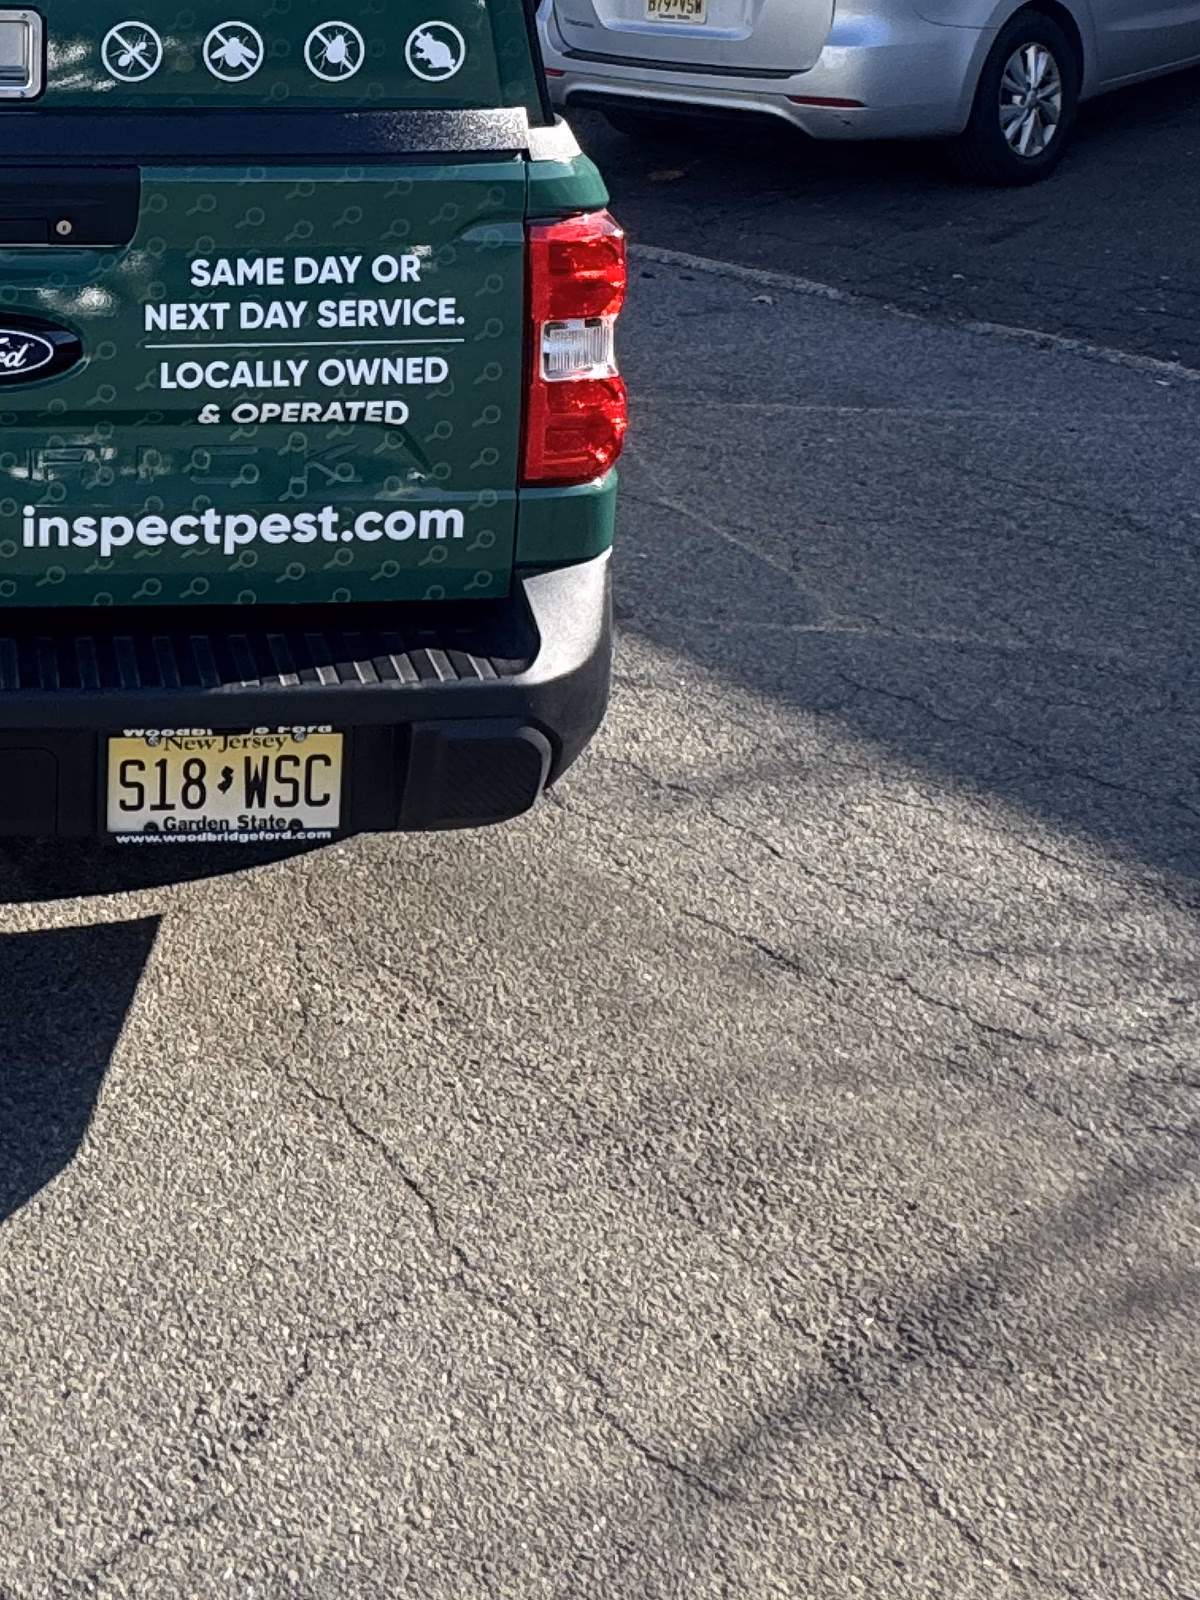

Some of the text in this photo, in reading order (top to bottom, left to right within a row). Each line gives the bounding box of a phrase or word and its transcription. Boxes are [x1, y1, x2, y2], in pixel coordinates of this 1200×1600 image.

[190, 254, 421, 287] SAME DAY OR
[145, 297, 465, 331] NEXT DAY SERVICE.
[160, 356, 449, 389] LOCALLY OWNED
[197, 400, 409, 425] & OPERATED
[23, 505, 465, 556] inspectpest.com
[163, 734, 289, 753] New Jersey
[118, 753, 332, 812] S18 WSC
[115, 830, 332, 844] www.woodbridgeford.com
[163, 813, 287, 831] Garden State
